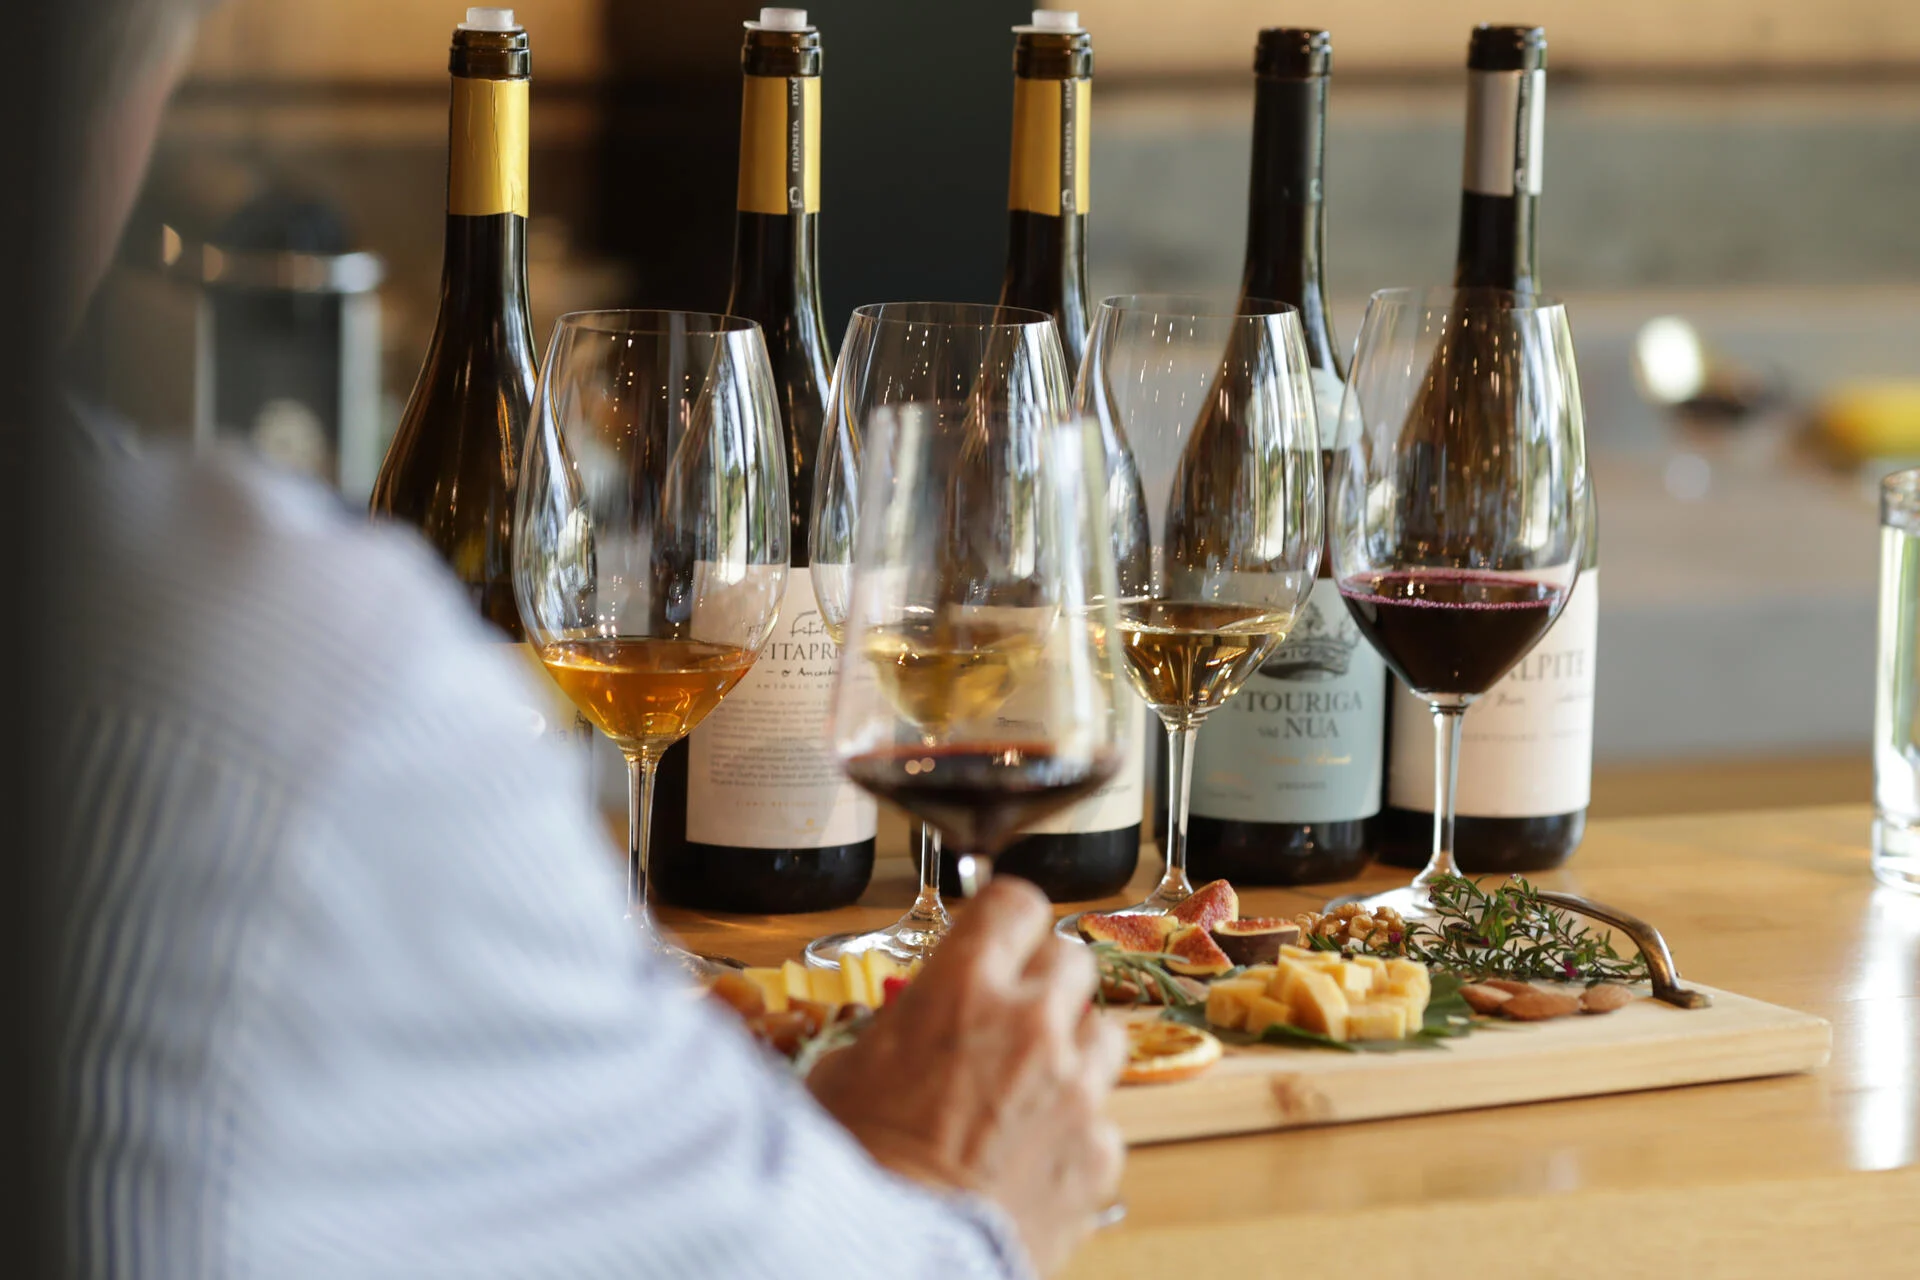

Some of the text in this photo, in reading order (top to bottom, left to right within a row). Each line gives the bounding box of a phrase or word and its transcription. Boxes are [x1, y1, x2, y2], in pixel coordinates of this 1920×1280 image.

[792, 120, 800, 172] FITAPRETA
[1242, 689, 1363, 714] TOURIGA
[1284, 716, 1340, 739] NUA
